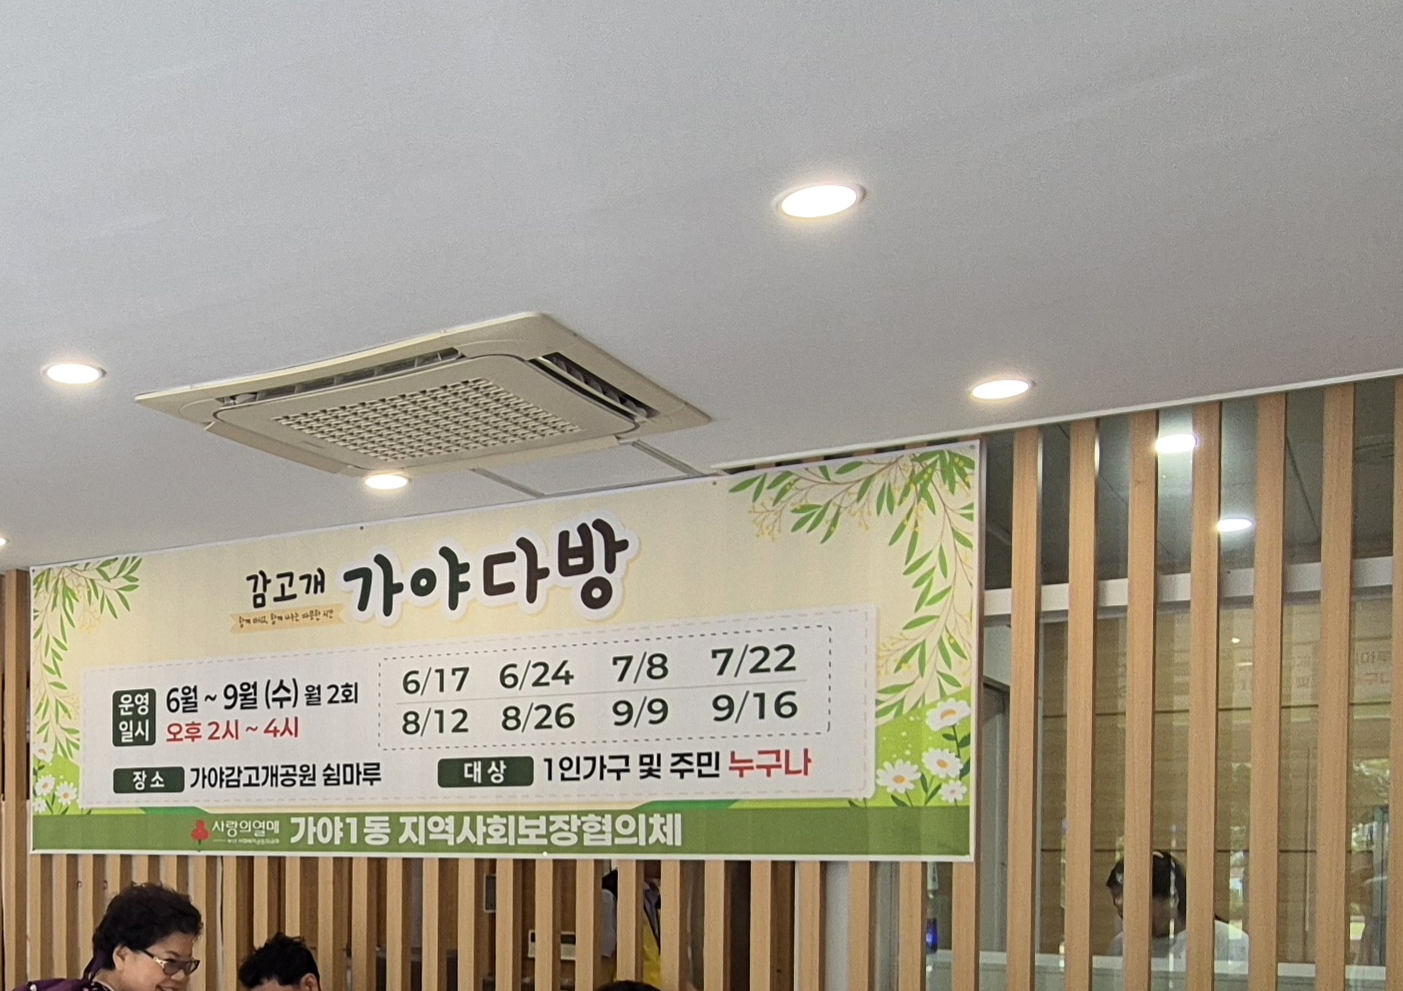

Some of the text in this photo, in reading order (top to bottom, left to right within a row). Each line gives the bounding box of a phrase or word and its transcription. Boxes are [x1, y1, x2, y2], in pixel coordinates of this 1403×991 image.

[246, 518, 629, 617] 감고개 가야다방
[401, 643, 797, 696] 6/17 6/24 7/8 7/22
[118, 692, 150, 716] 운영
[166, 684, 199, 713] 6월
[223, 681, 258, 711] 9월
[264, 678, 299, 709] (수)
[304, 684, 322, 706] 월
[326, 682, 359, 705] 2회
[166, 721, 202, 742] 오후
[207, 719, 239, 740] 2시
[263, 716, 299, 738] 4시
[401, 690, 798, 737] 8/12 8/26 9/9 9/16
[119, 719, 150, 743] 일시
[190, 763, 317, 789] 가야감고개공원
[322, 762, 382, 787] 쉼마루
[543, 754, 631, 781] 1인가구
[638, 753, 662, 780] 및
[670, 751, 721, 779] 주민
[728, 748, 812, 778] 누구나
[212, 820, 280, 838] 사랑의열매
[289, 813, 682, 847] 가야1동 지역사회보장협의체
